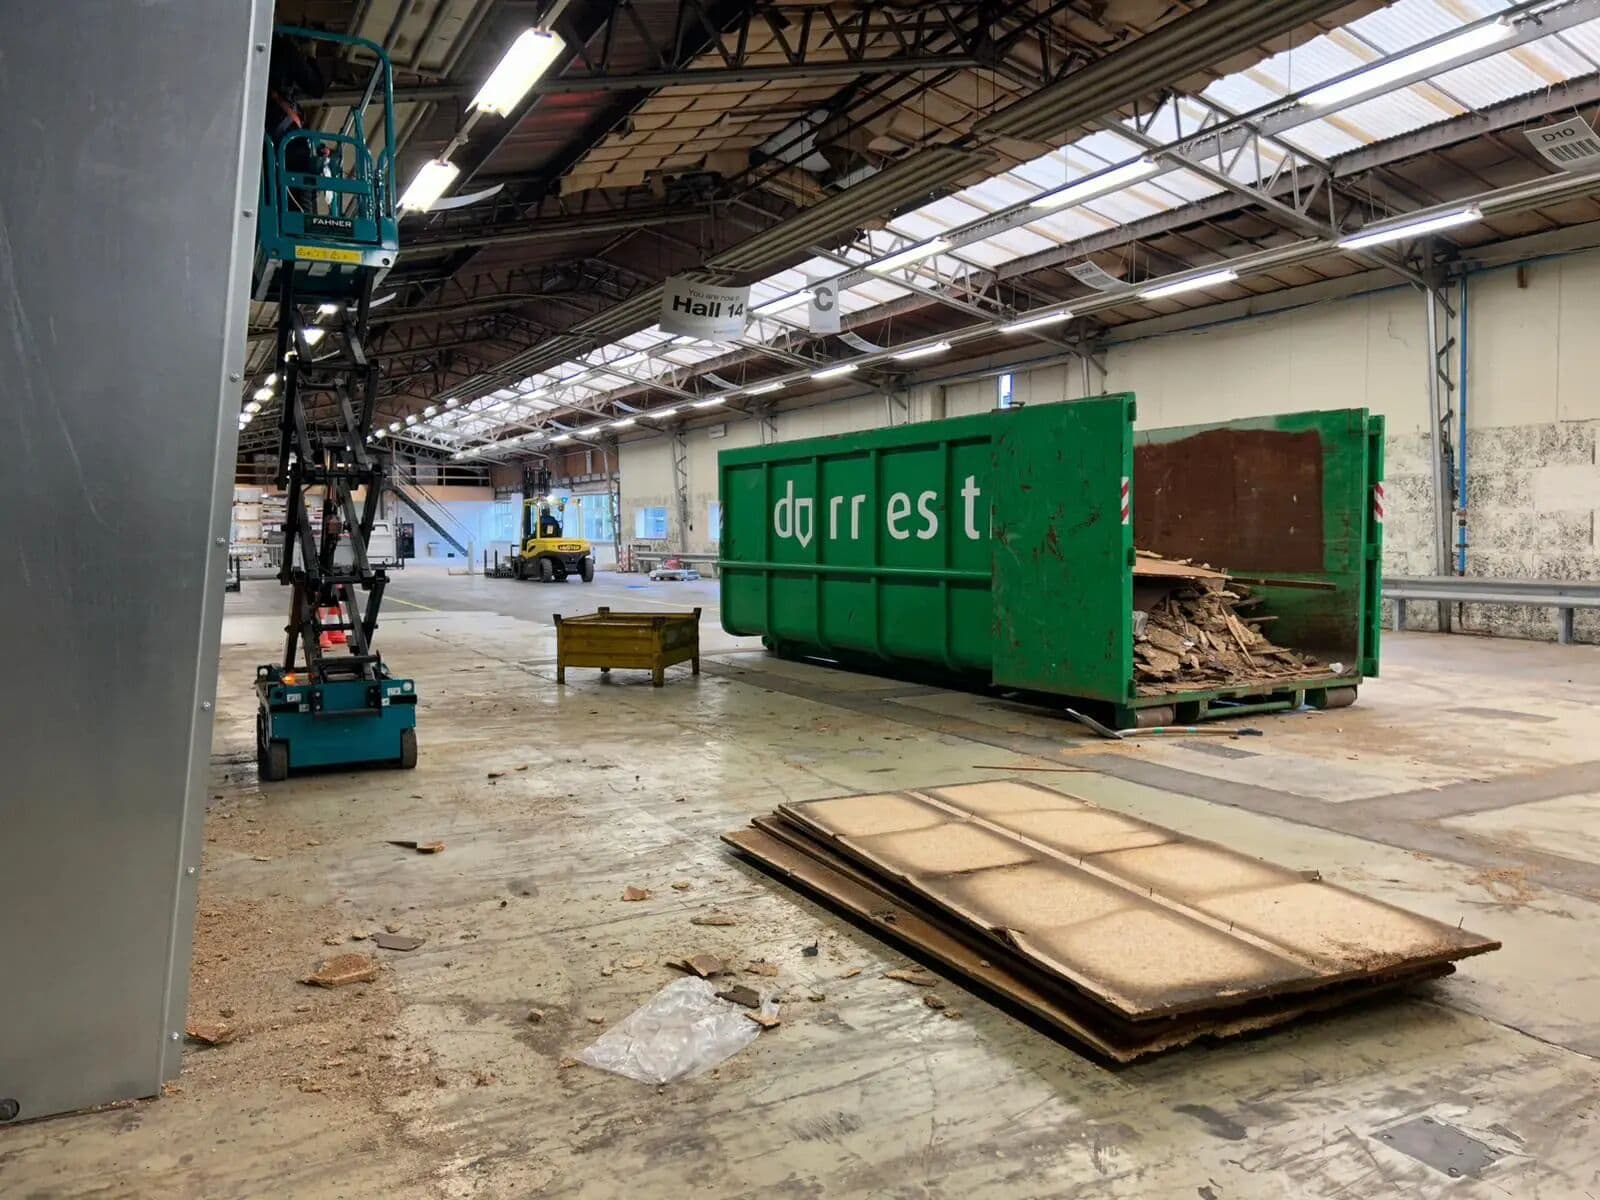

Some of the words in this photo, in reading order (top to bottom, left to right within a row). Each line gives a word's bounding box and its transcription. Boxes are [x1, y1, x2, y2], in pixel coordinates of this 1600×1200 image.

[1542, 128, 1575, 142] D10
[312, 218, 352, 228] FAHNER
[688, 288, 704, 299] You
[814, 286, 834, 312] C
[672, 295, 722, 319] Hall
[727, 303, 744, 319] 14
